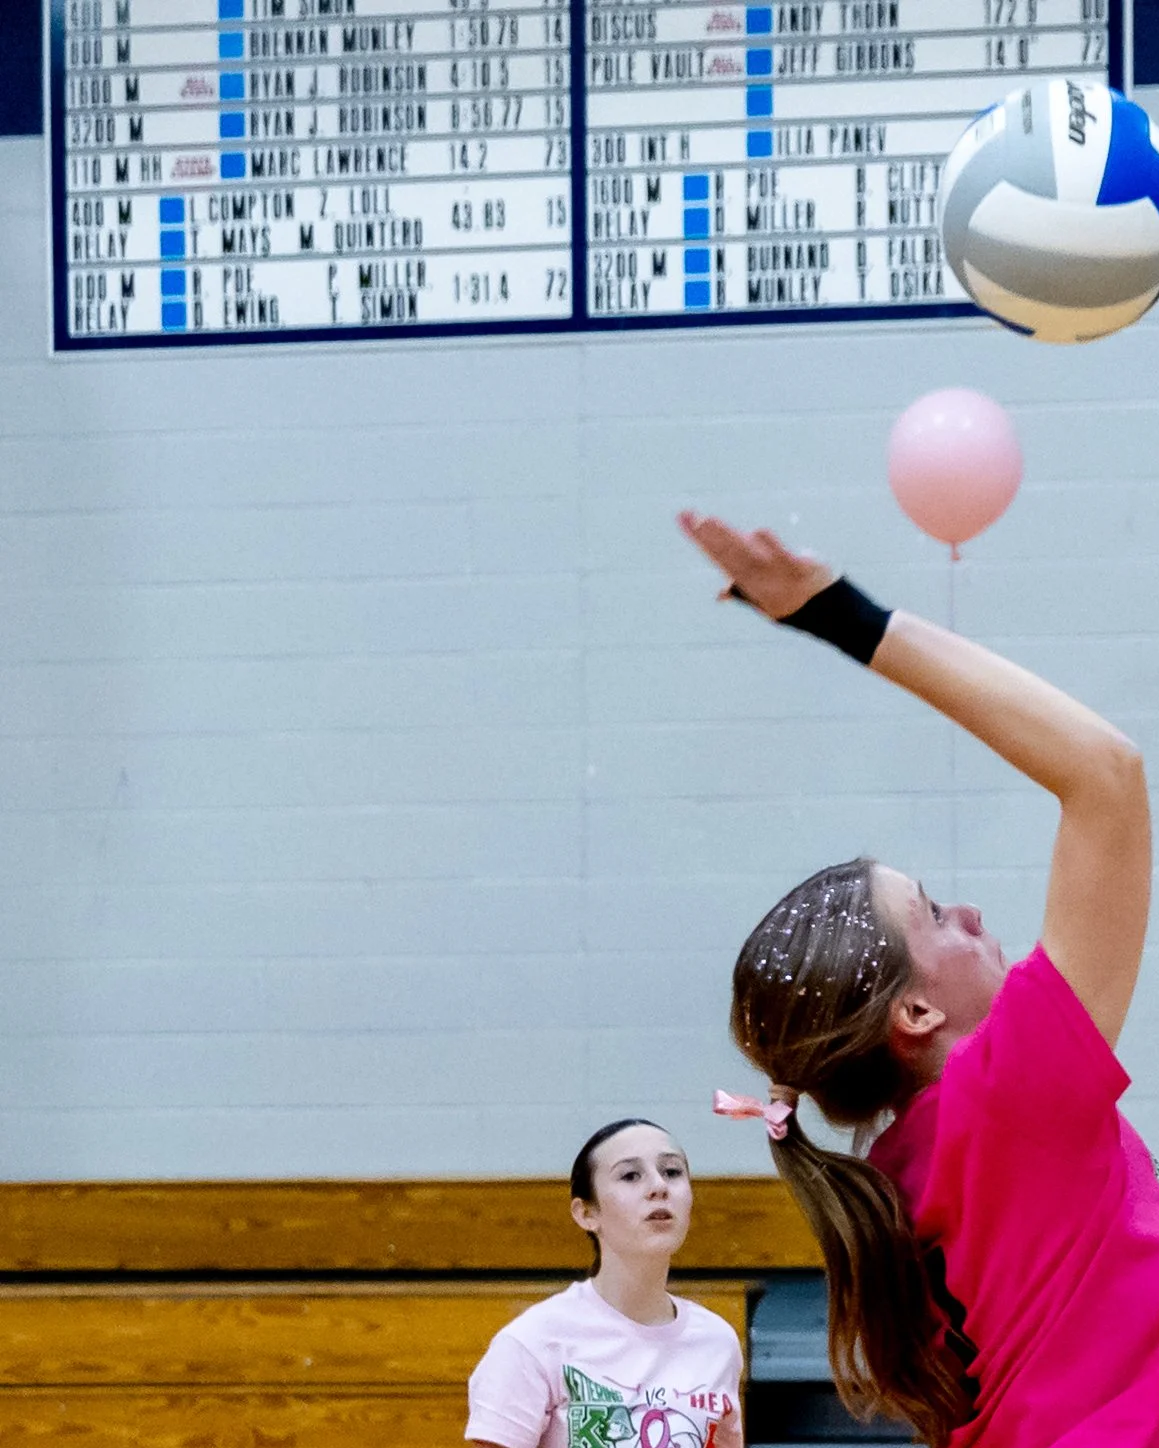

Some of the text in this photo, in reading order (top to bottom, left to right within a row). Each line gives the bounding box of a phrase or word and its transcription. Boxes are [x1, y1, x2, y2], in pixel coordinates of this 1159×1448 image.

[591, 11, 657, 42] DISCUS
[592, 53, 633, 84] POLE
[651, 50, 704, 81] VAULT
[779, 44, 819, 76] JEFF
[125, 73, 140, 102] M
[250, 70, 295, 100] RYAN
[129, 112, 144, 142] M
[250, 110, 295, 138] RYAN
[116, 153, 130, 184] M
[251, 145, 407, 179] MARC LAWRENCE
[646, 175, 661, 204] M
[117, 195, 132, 225] M
[593, 209, 650, 238] RELAY
[72, 231, 128, 262] RELAY
[222, 225, 271, 257] MAYS
[652, 247, 667, 278] M
[121, 268, 136, 299] M
[594, 281, 652, 310] RELAY
[74, 301, 130, 333] RELAY
[360, 288, 419, 324] SIMON
